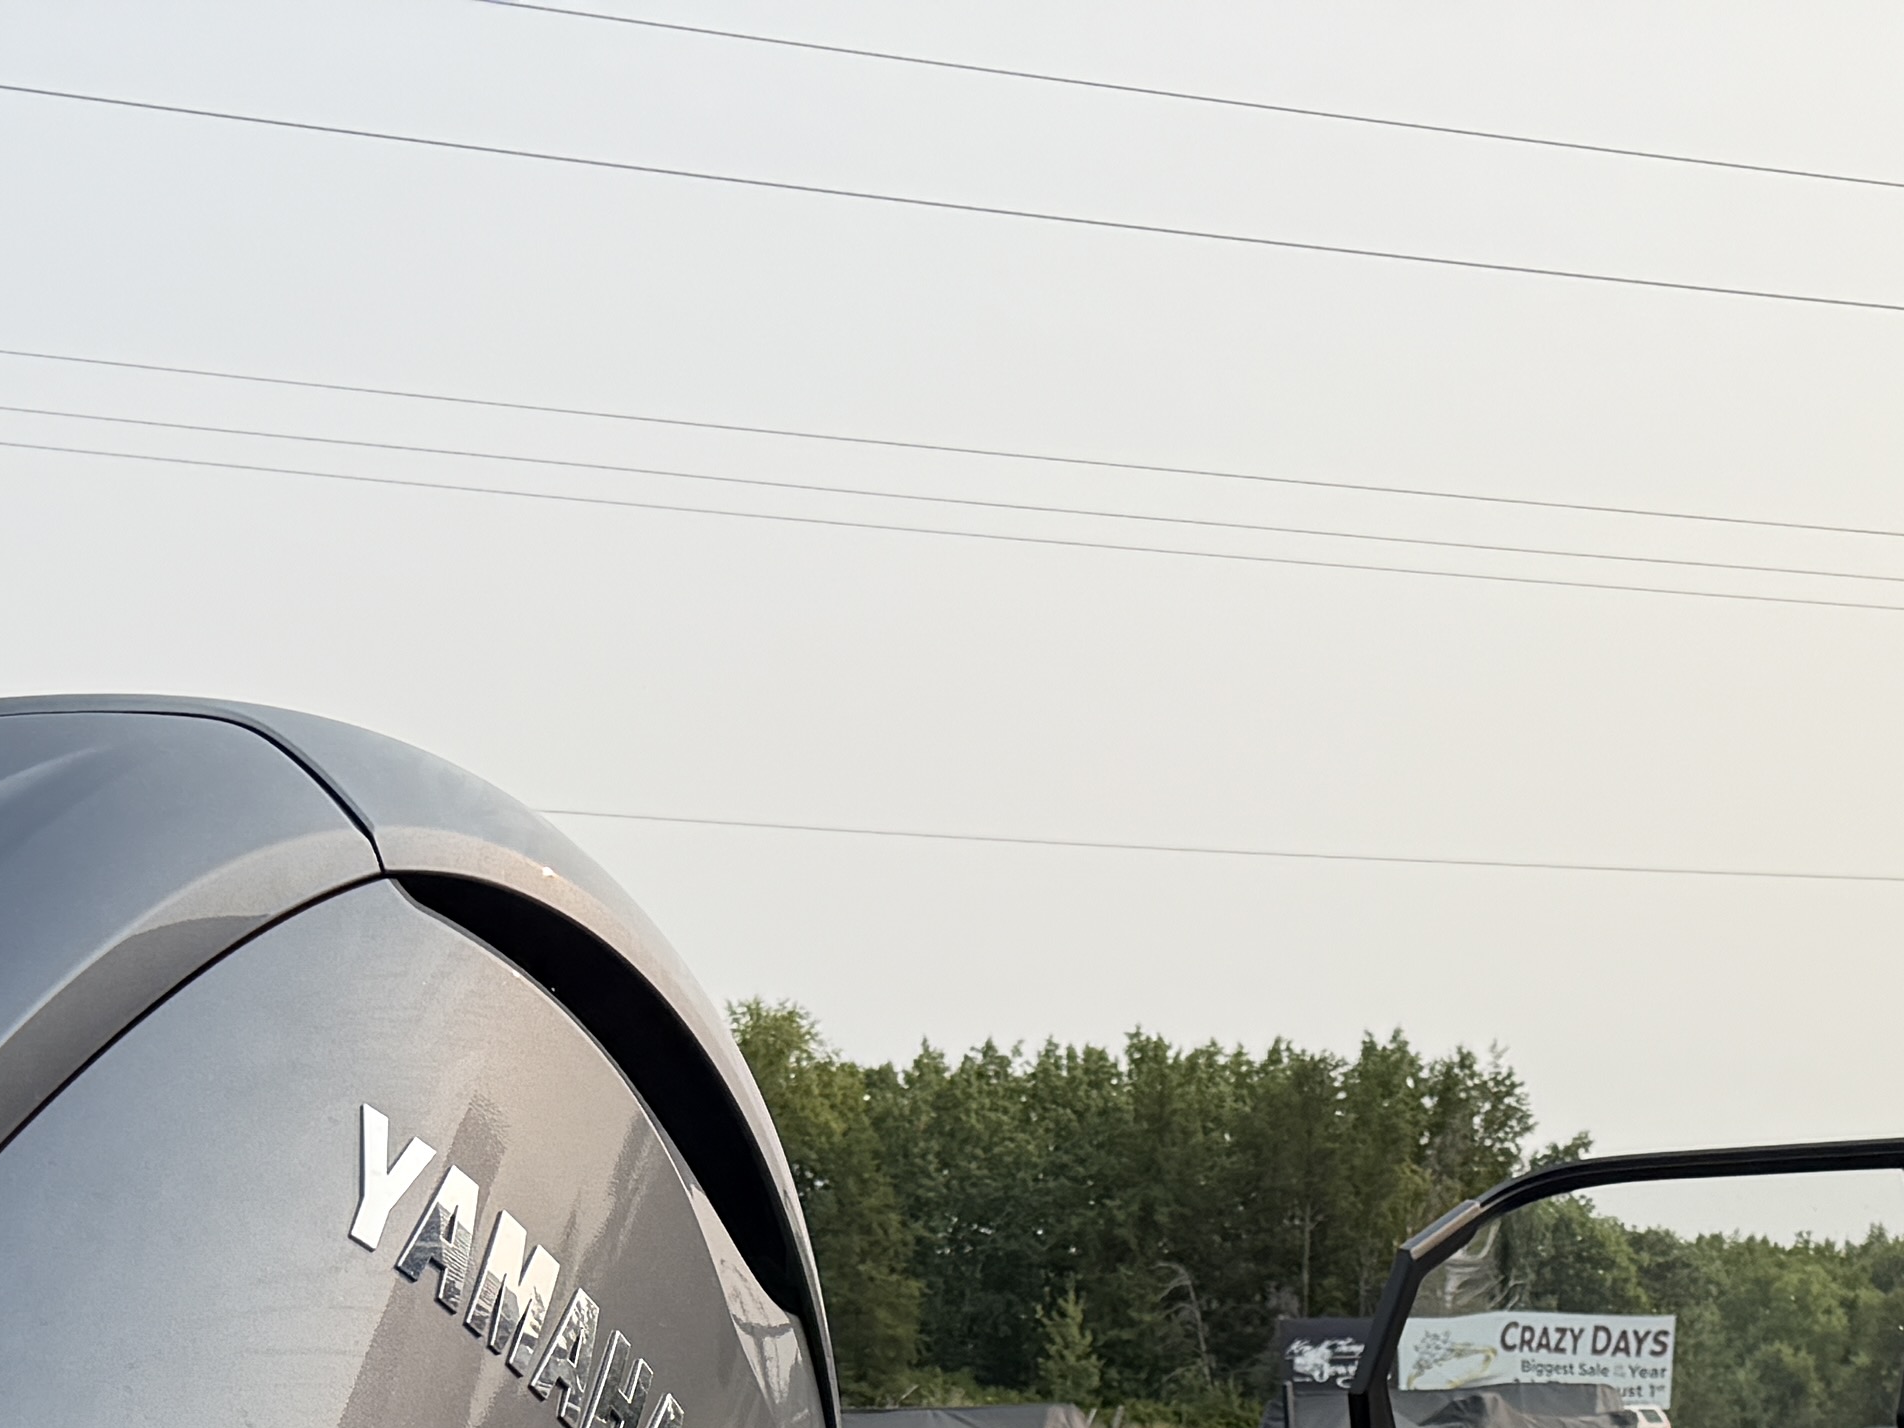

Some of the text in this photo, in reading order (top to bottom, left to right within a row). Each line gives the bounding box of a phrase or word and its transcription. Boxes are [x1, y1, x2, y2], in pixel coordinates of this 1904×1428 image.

[1500, 1321, 1670, 1358] CRAZY DAYS
[1521, 1359, 1575, 1378] Biggest
[1578, 1361, 1610, 1378] Sale
[1628, 1364, 1668, 1379] Year
